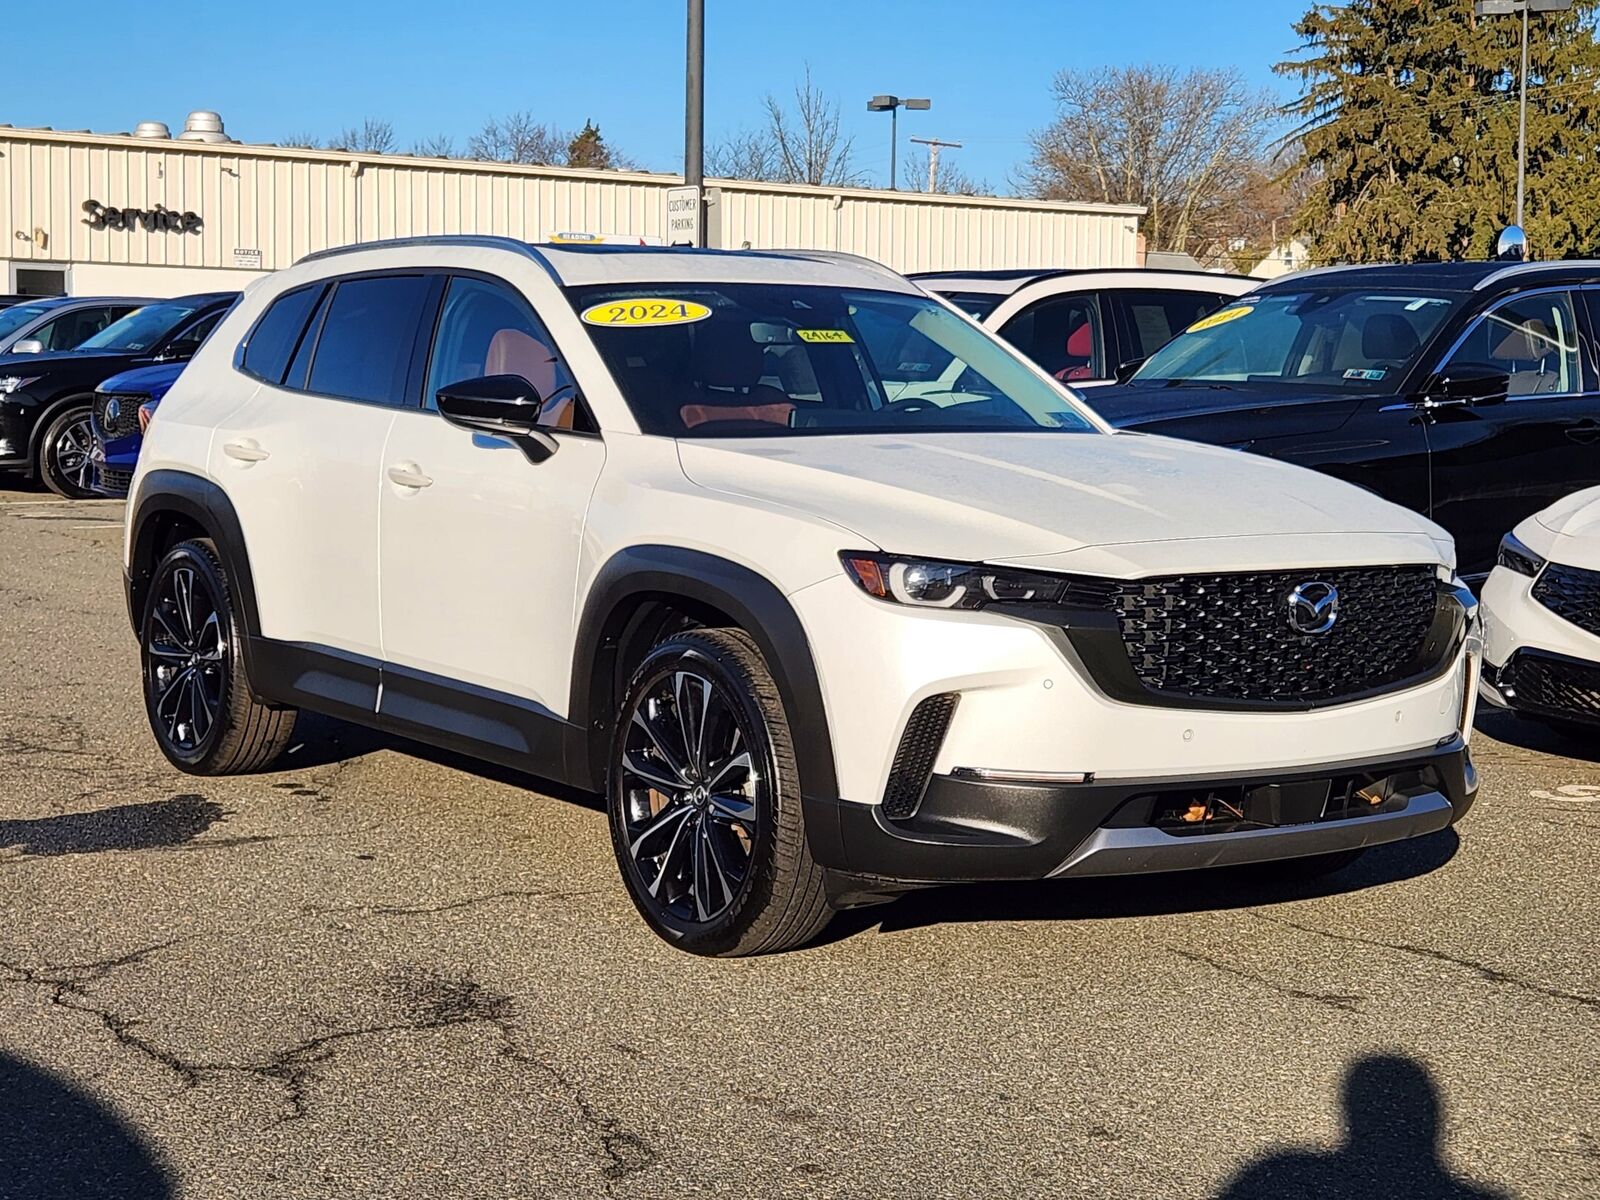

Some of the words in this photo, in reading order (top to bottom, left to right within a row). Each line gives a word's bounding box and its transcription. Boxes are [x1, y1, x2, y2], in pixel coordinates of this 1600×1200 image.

[669, 198, 697, 212] CUSTOMER
[81, 199, 204, 236] Service
[671, 217, 694, 231] PARKING
[609, 303, 691, 323] 2024
